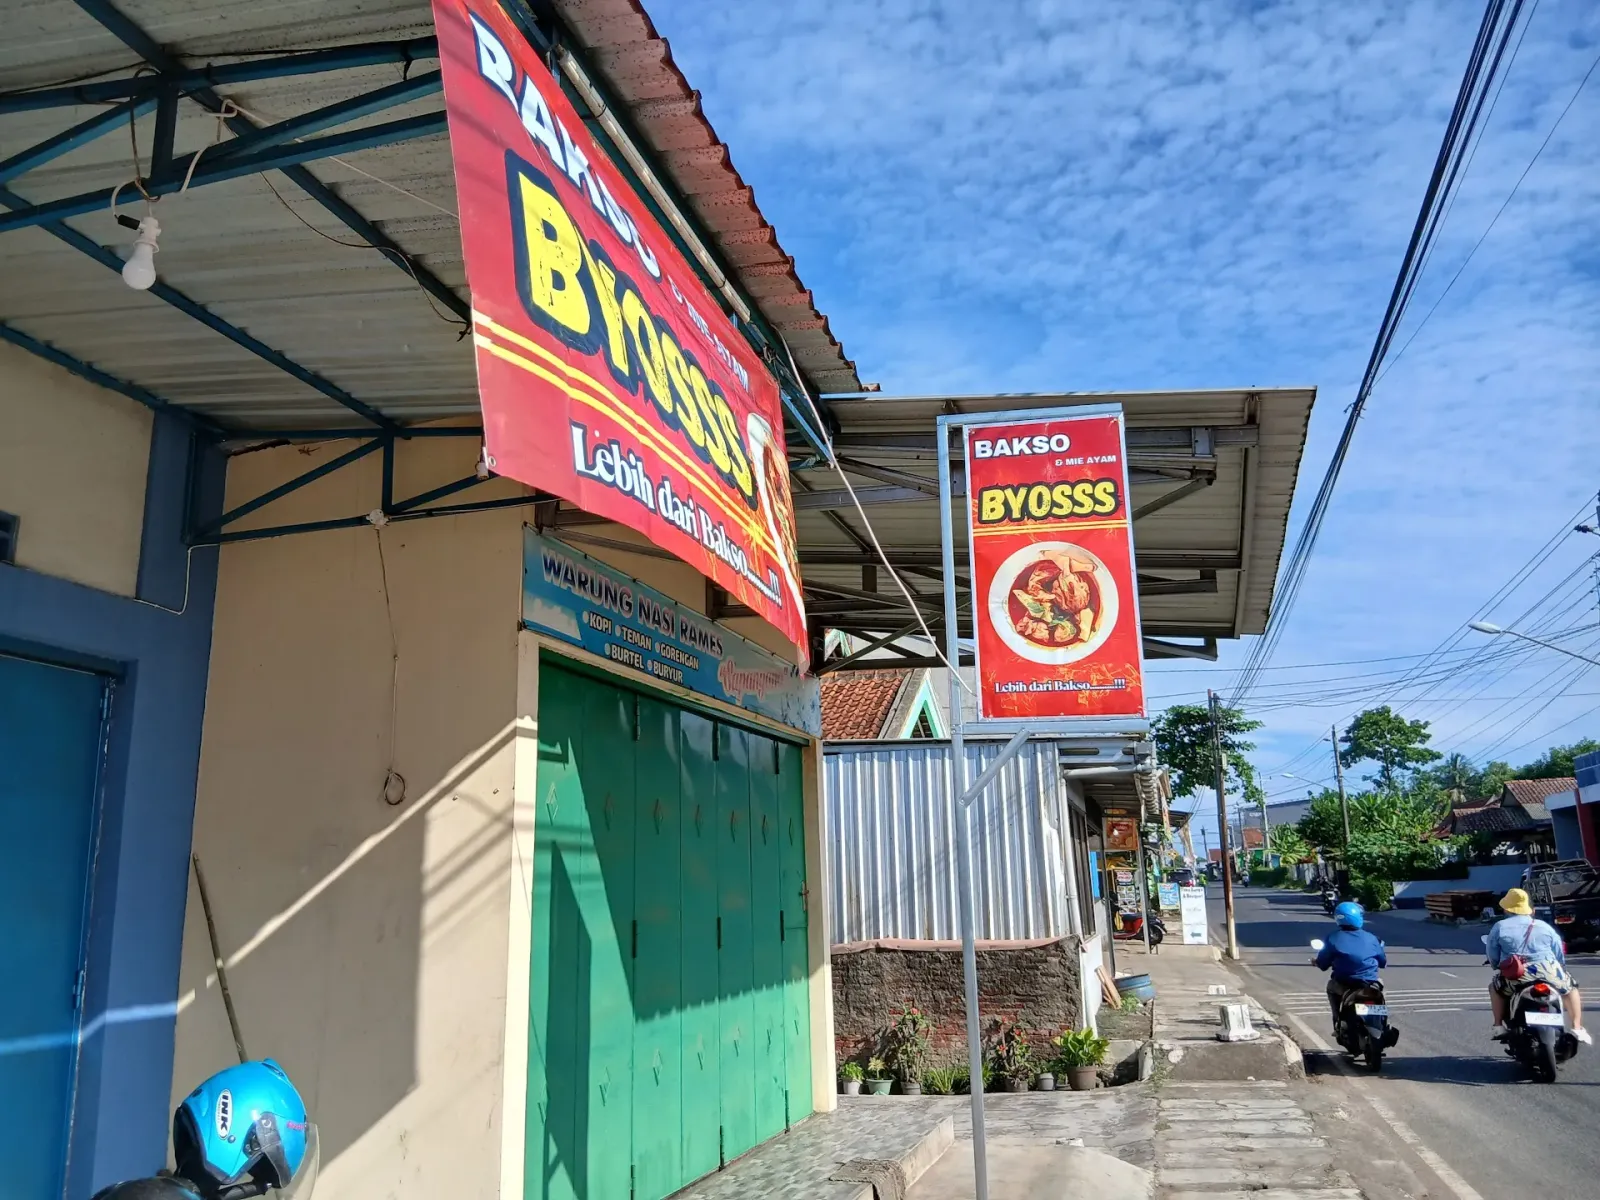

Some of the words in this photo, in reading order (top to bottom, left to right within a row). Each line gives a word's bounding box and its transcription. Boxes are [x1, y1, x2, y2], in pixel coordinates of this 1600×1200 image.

[512, 158, 757, 505] BYOSSS
[974, 433, 1071, 459] BAKSO
[1055, 459, 1064, 467] &
[1065, 457, 1085, 466] MIE
[1086, 455, 1117, 465] AYAM
[569, 420, 656, 514] Lebih
[657, 480, 700, 542] dari
[980, 480, 1117, 523] BYOSSS
[540, 546, 633, 617] WARUNG
[638, 594, 676, 638] NASI
[679, 612, 724, 659] RAMES
[589, 612, 613, 635] KOPI
[620, 627, 652, 651] TEMAN
[660, 642, 699, 671] GORENGAN
[611, 646, 645, 670] BURTEL
[652, 661, 684, 685] BURYUR
[994, 681, 1028, 694] Lebih
[1029, 680, 1053, 692] dari
[220, 1094, 229, 1132] INK
